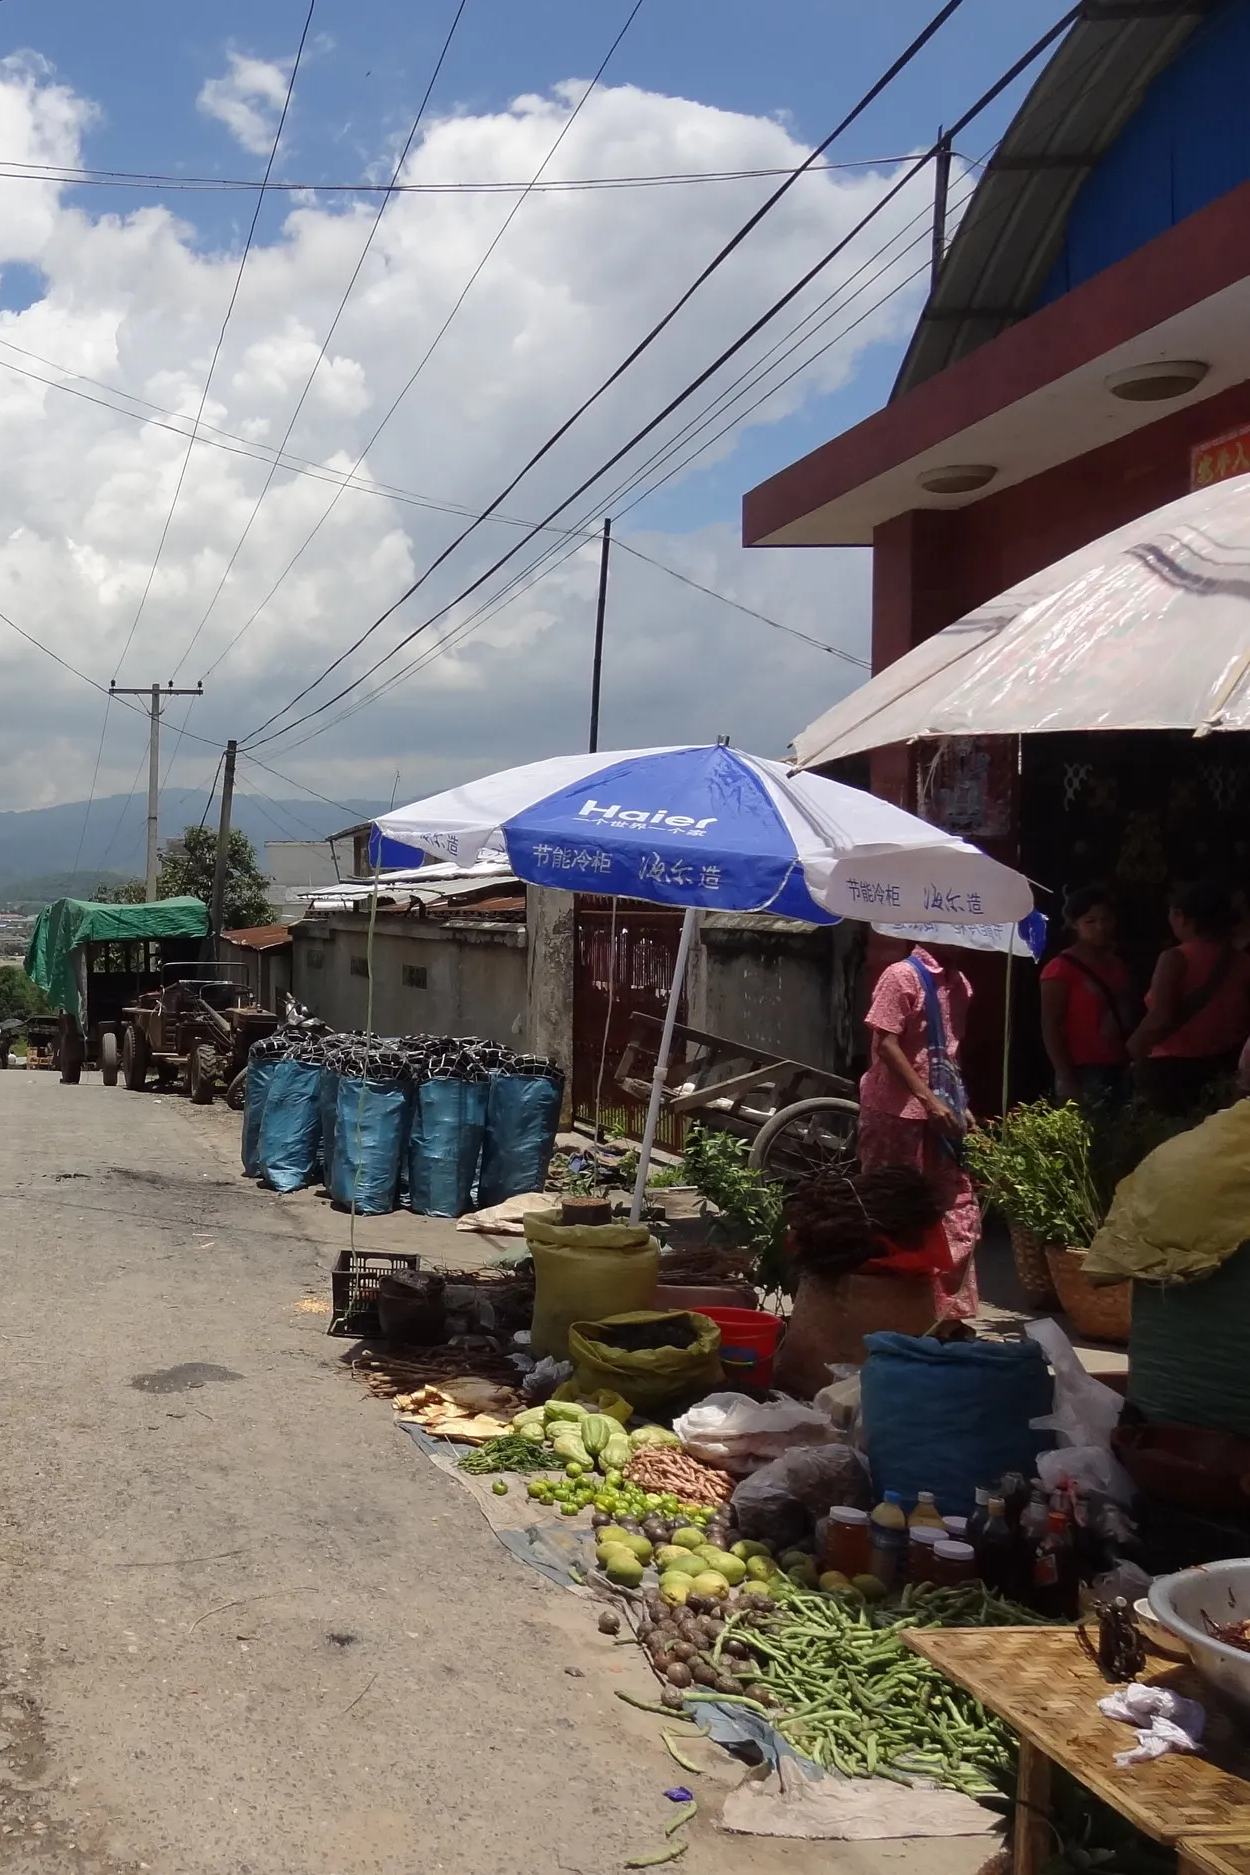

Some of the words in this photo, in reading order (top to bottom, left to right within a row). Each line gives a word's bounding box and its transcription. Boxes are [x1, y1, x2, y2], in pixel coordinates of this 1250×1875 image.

[573, 817, 707, 837] 一个世界一个家
[578, 800, 718, 829] Haier
[532, 843, 614, 874] 节能冷柜
[846, 878, 901, 907] 节能冷柜
